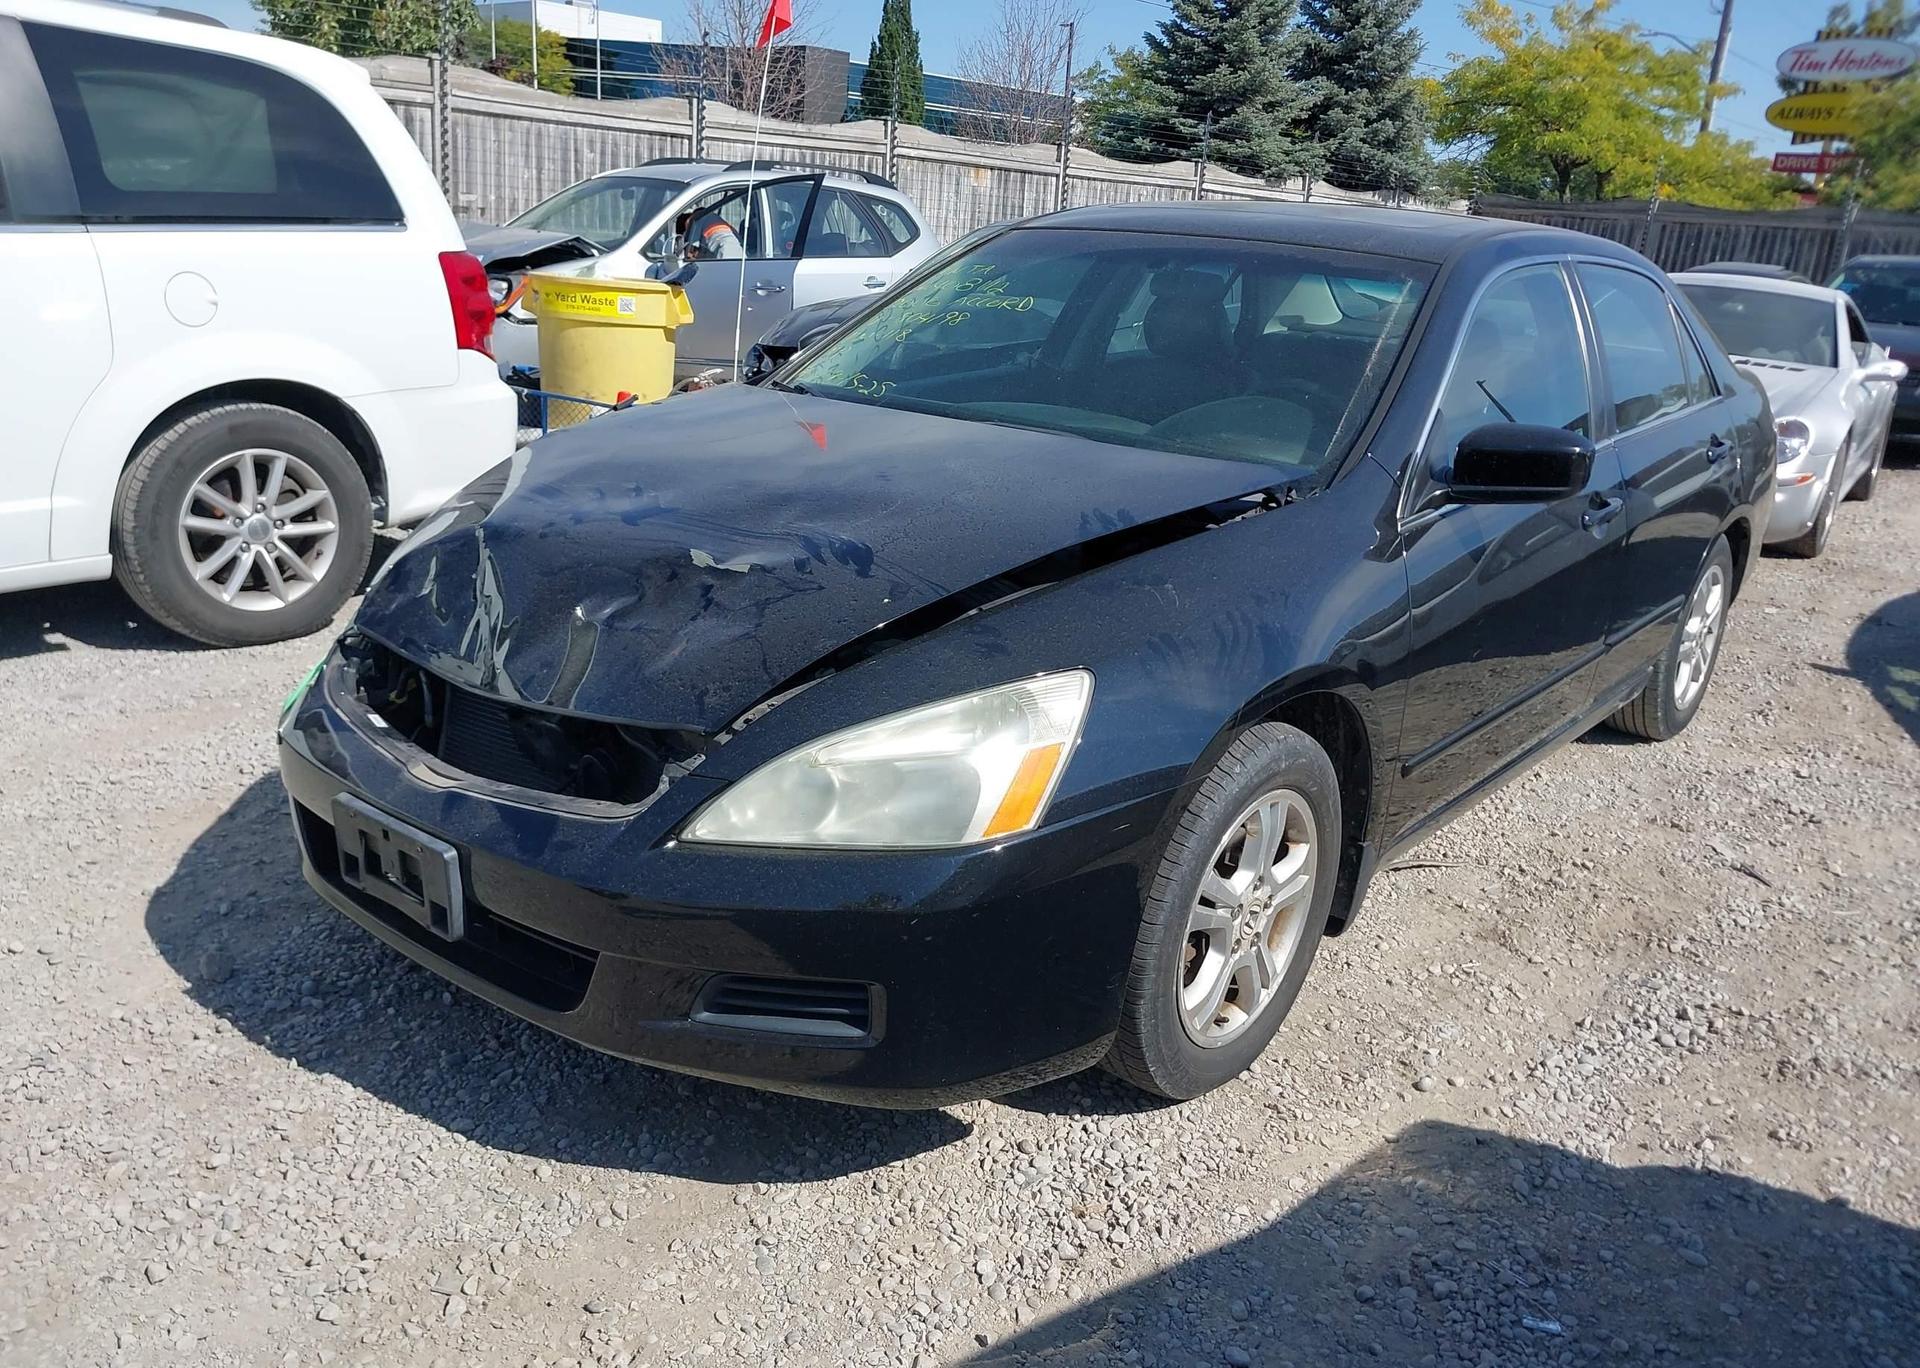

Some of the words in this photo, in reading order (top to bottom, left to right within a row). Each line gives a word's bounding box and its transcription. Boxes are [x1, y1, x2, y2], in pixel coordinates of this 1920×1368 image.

[1789, 49, 1826, 72] Tim
[1774, 107, 1835, 121] ALWAYS
[1776, 156, 1818, 168] DRIVE
[554, 291, 577, 303] Yard
[579, 294, 616, 307] Waste
[945, 296, 1034, 312] ACCORD
